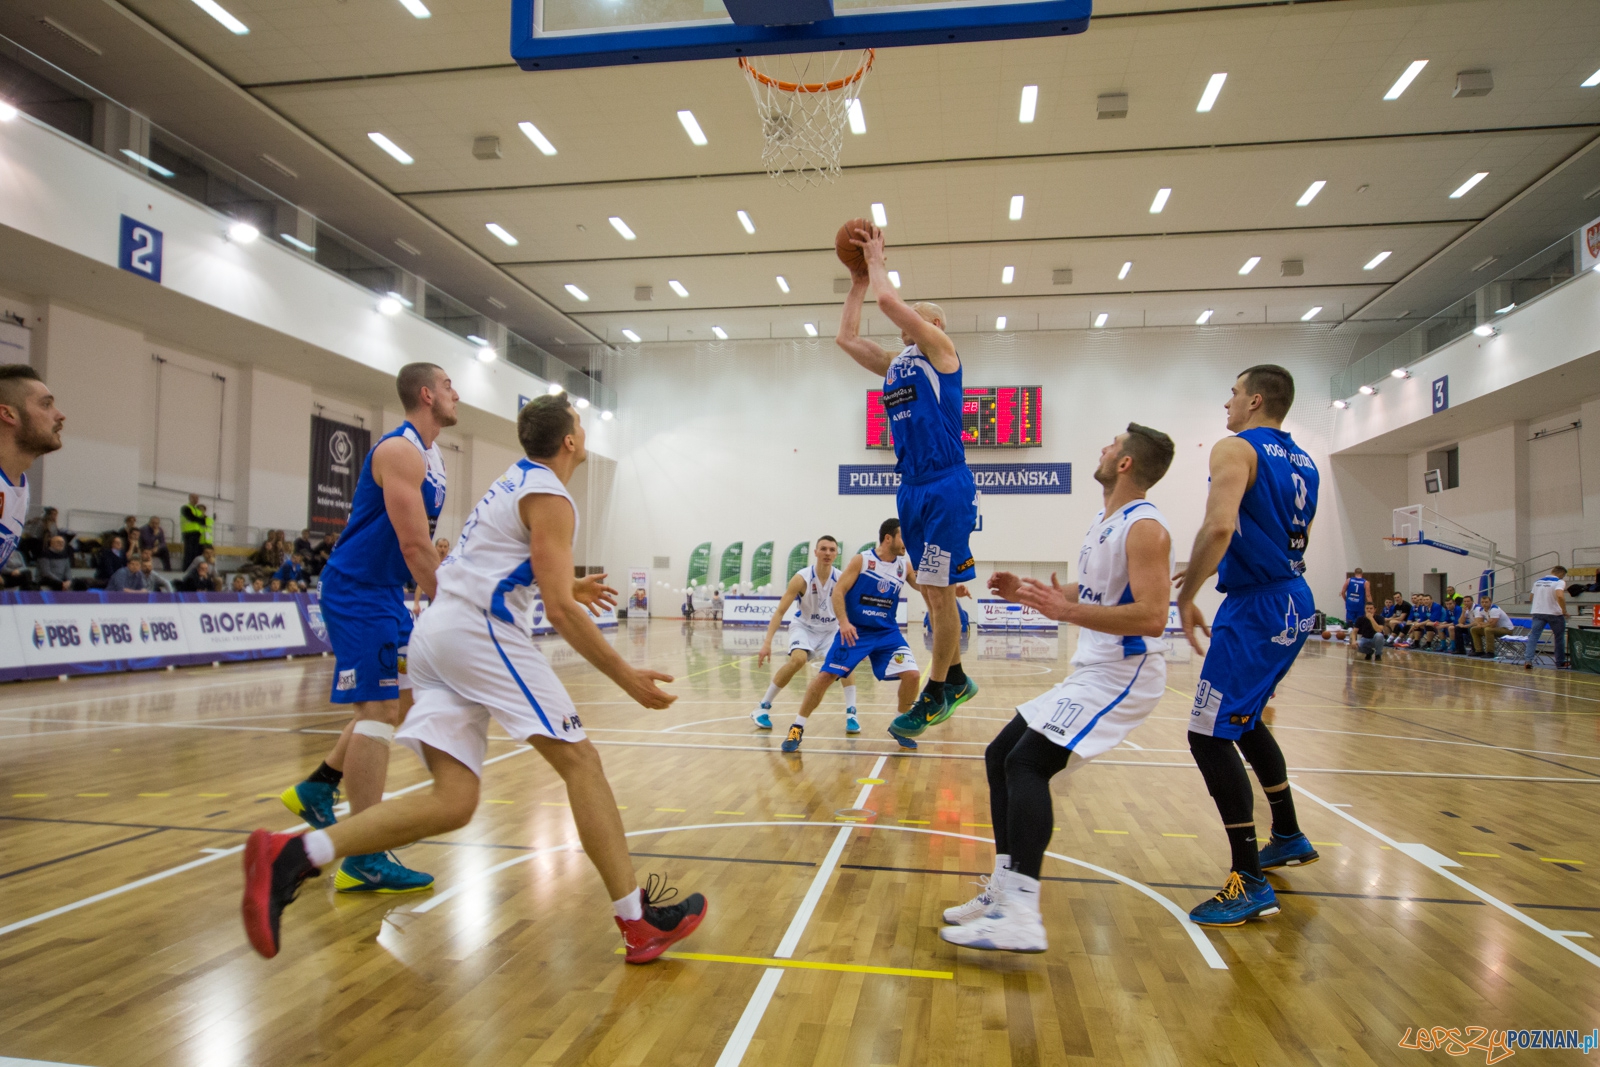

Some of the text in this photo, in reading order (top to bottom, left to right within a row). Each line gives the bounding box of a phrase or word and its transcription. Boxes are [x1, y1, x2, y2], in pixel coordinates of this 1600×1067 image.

[131, 226, 153, 274] 2
[1435, 381, 1444, 409] 3
[850, 469, 1060, 487] POLITE OZNAŃSKA
[733, 603, 778, 616] rehaspo
[100, 623, 132, 645] PBG
[149, 622, 178, 642] PBG
[199, 612, 286, 634] BIOFARM
[46, 625, 81, 648] PBG
